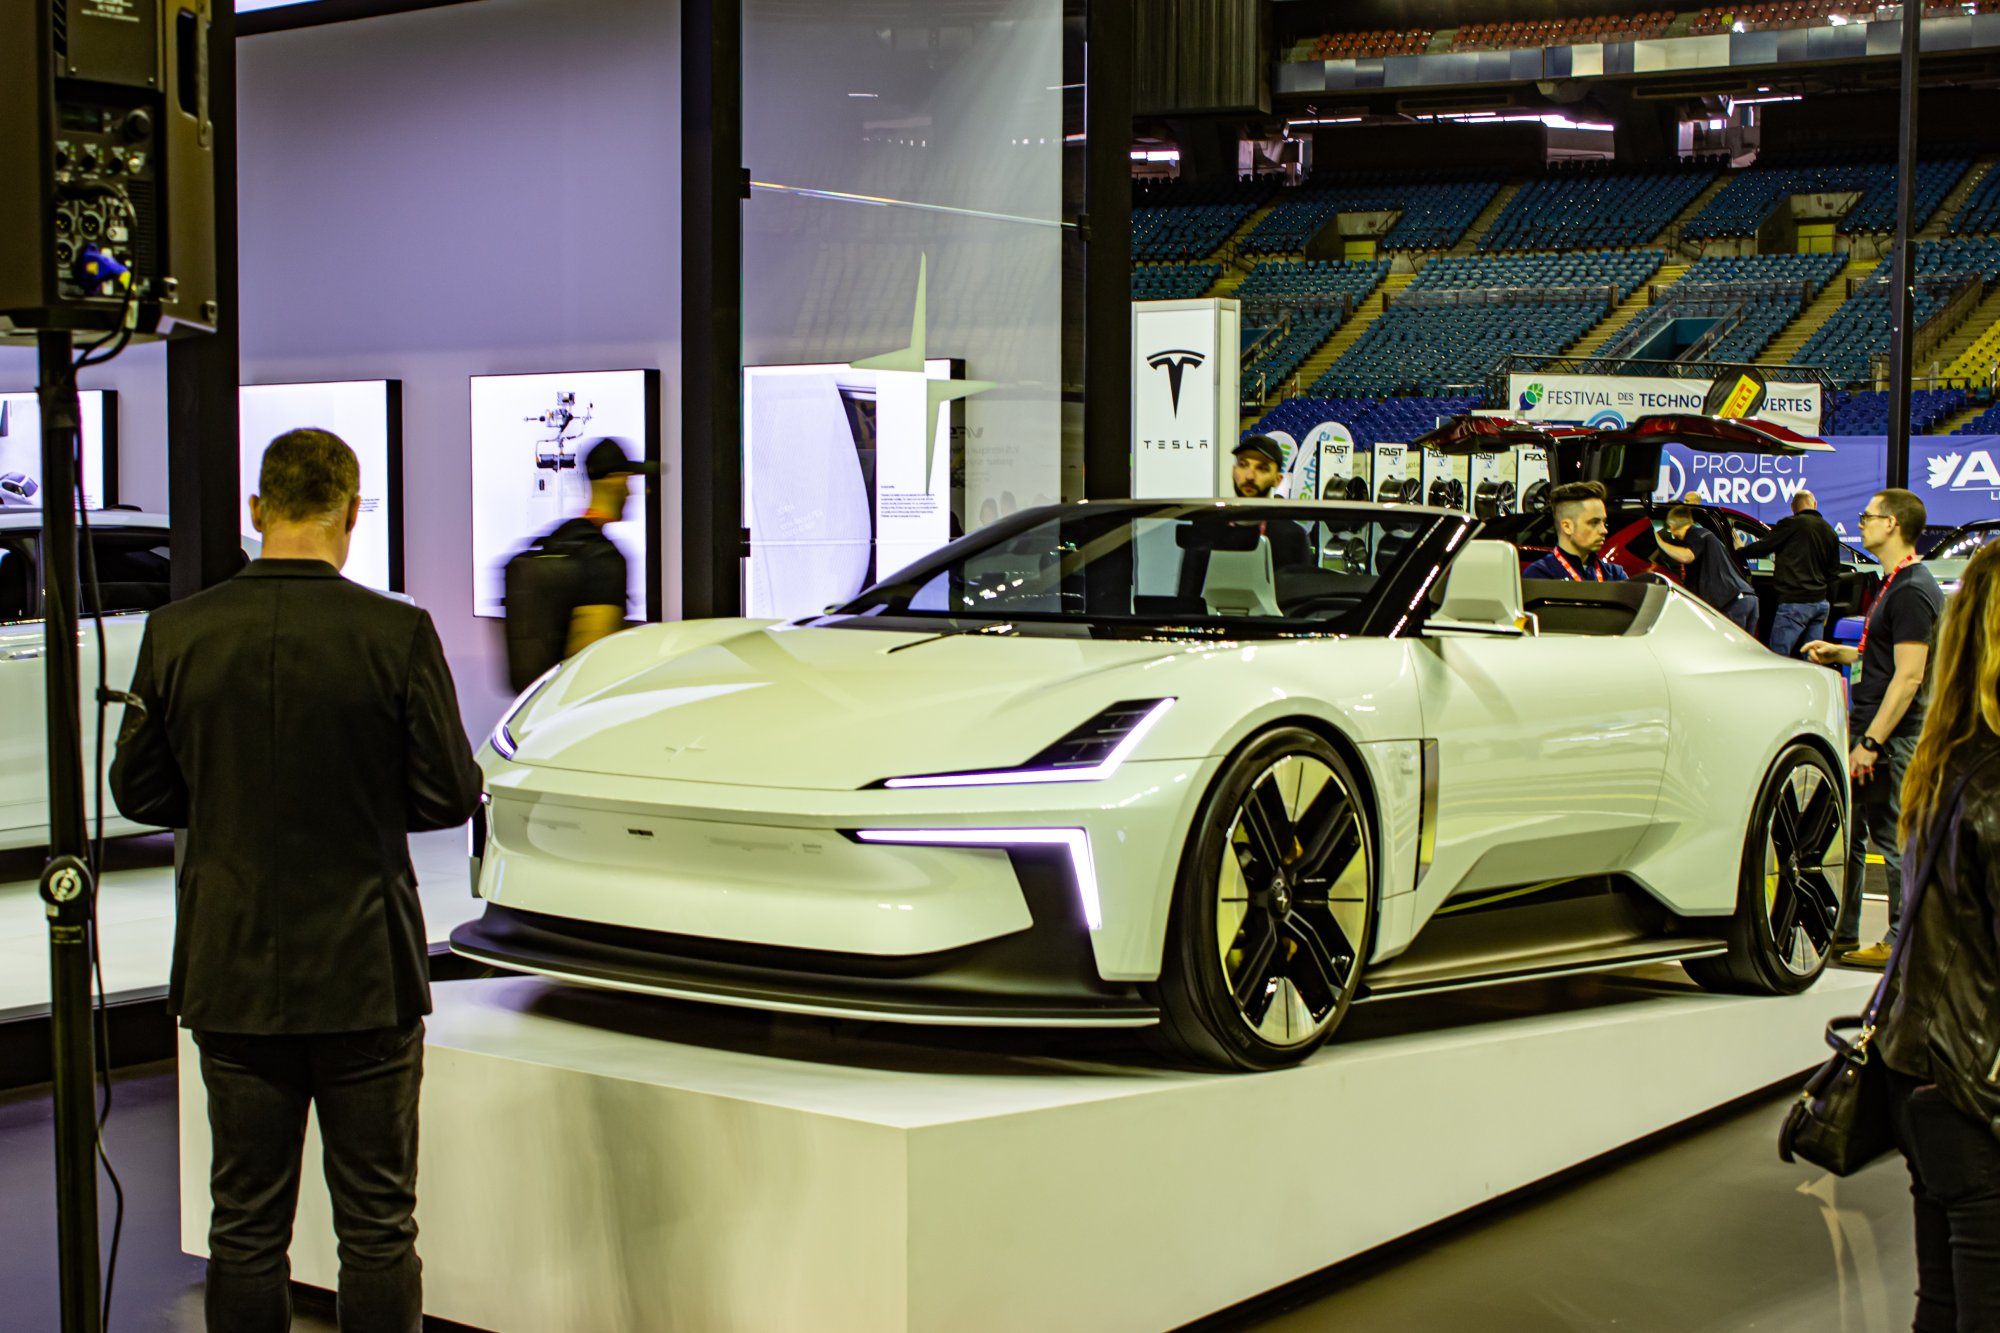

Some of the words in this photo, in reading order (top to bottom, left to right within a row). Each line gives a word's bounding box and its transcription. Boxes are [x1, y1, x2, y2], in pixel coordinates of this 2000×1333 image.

[1547, 390, 1612, 405] FESTIVAL
[1617, 392, 1634, 401] DES
[1761, 397, 1812, 411] VERTES
[1143, 440, 1208, 449] TESLA
[1324, 445, 1350, 454] FAST
[1379, 447, 1404, 457] FAST
[1693, 454, 1809, 474] PROJECT
[1696, 477, 1807, 504] ARROW
